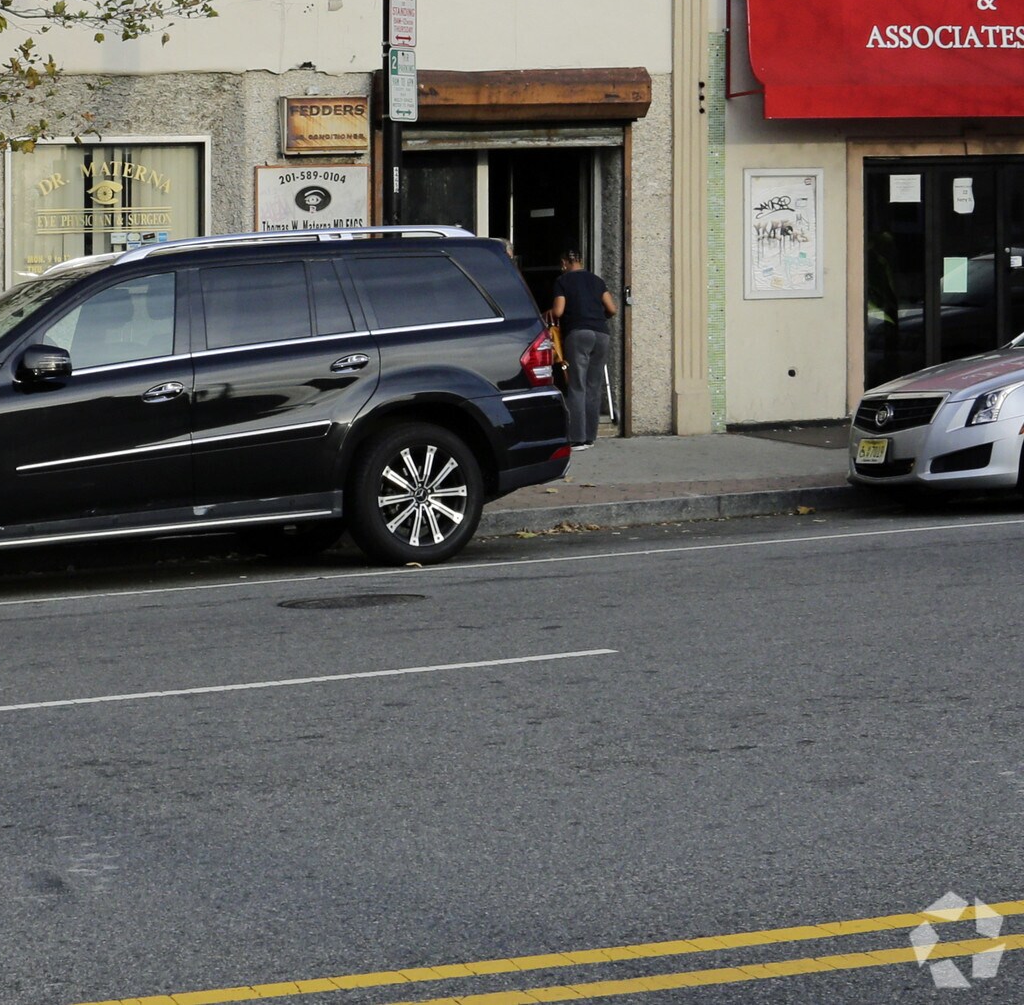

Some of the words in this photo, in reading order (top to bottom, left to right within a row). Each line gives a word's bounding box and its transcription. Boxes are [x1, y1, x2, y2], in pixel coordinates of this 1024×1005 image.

[392, 7, 415, 17] STANDING
[865, 25, 1024, 49] ASSOCIATES
[391, 55, 397, 69] 2
[289, 104, 365, 116] FEDDERS
[38, 171, 72, 197] DR.
[79, 160, 172, 194] MATERNA
[278, 170, 346, 185] 201-589-0104
[37, 214, 57, 228] EYE
[61, 213, 113, 228] PHYSICIAN
[116, 214, 125, 226] &
[128, 211, 173, 226] SURGEON
[262, 221, 289, 232] Thomas
[303, 219, 331, 230] Materna
[27, 255, 45, 264] MON.
